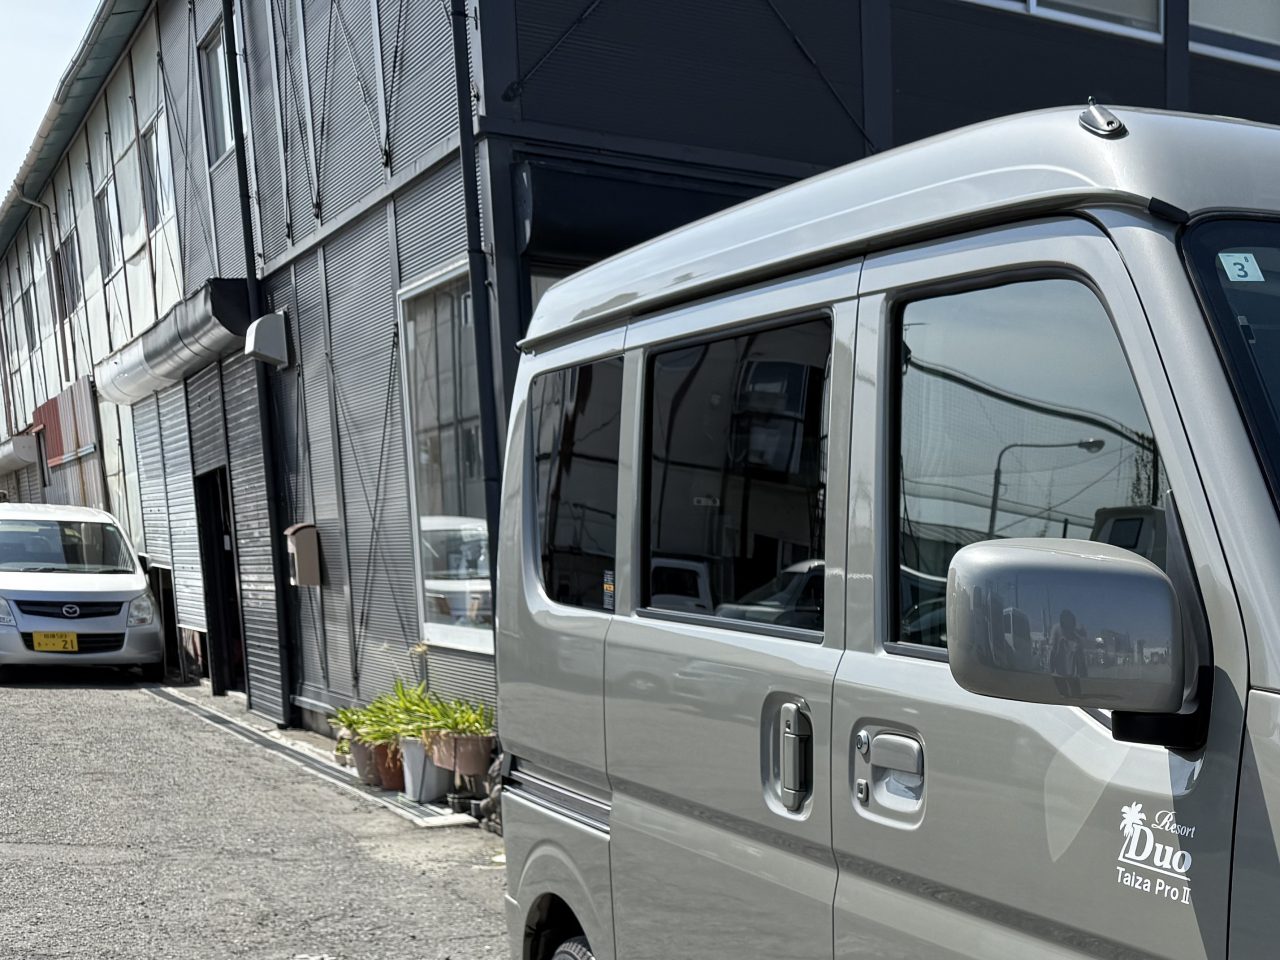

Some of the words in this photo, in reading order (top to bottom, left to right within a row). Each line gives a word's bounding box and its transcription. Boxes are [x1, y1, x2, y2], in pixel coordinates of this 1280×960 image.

[1233, 262, 1248, 278] 3
[1151, 810, 1196, 839] Resort
[1124, 824, 1193, 873] Duo
[1116, 866, 1151, 893] Taiza
